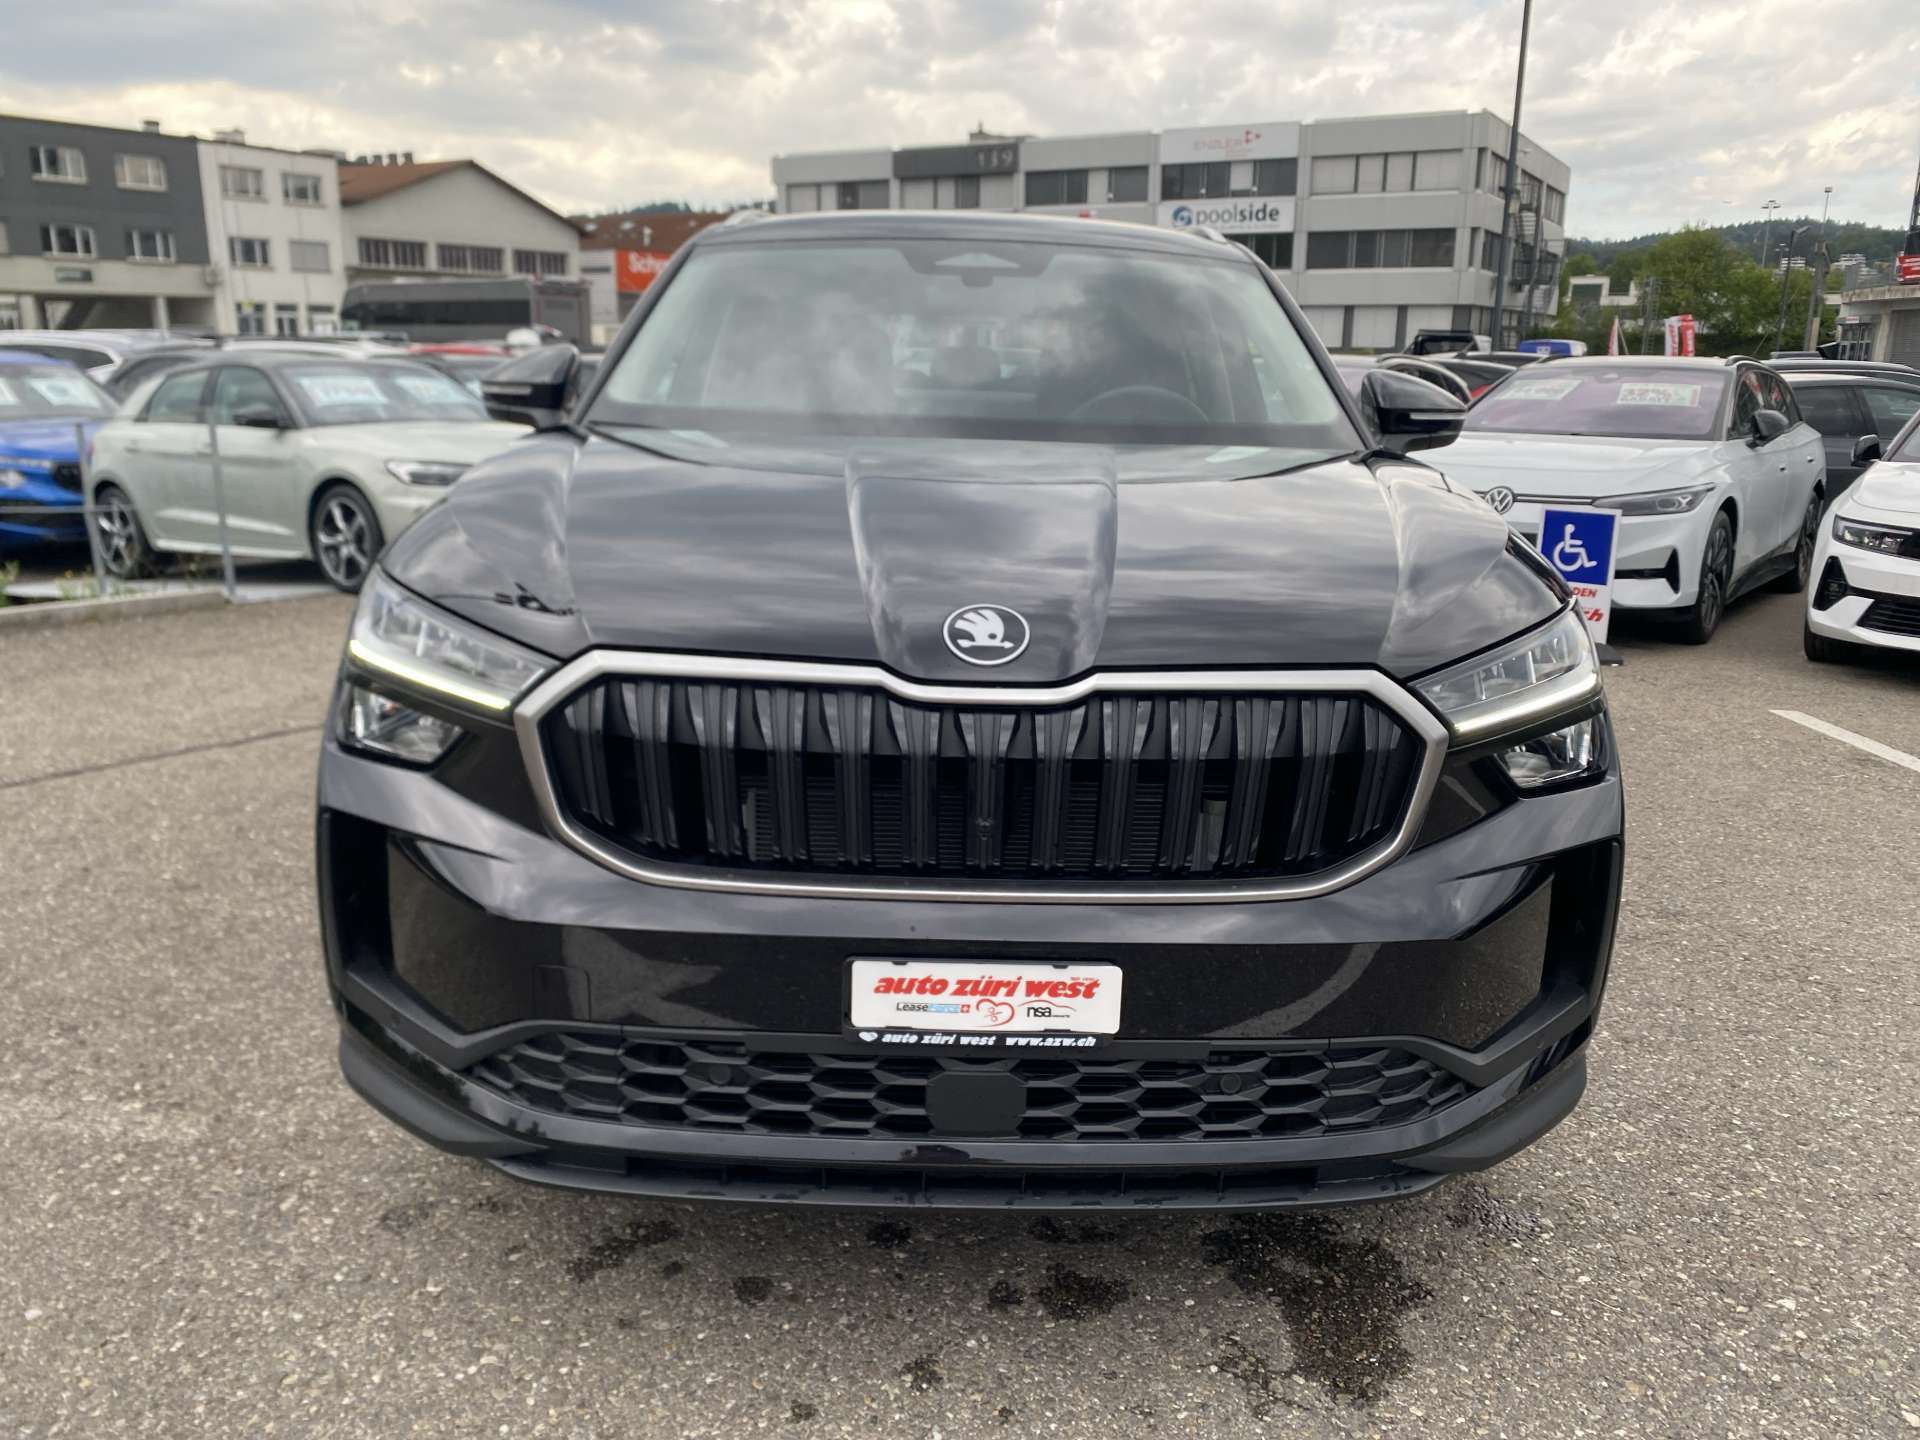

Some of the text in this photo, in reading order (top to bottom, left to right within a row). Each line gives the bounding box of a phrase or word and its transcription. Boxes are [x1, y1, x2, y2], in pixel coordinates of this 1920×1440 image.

[1196, 203, 1280, 225] poolside
[1572, 586, 1598, 598] DEN
[874, 976, 1100, 999] auto züri west
[881, 1033, 1096, 1047] auto züri west www.azw.ch
